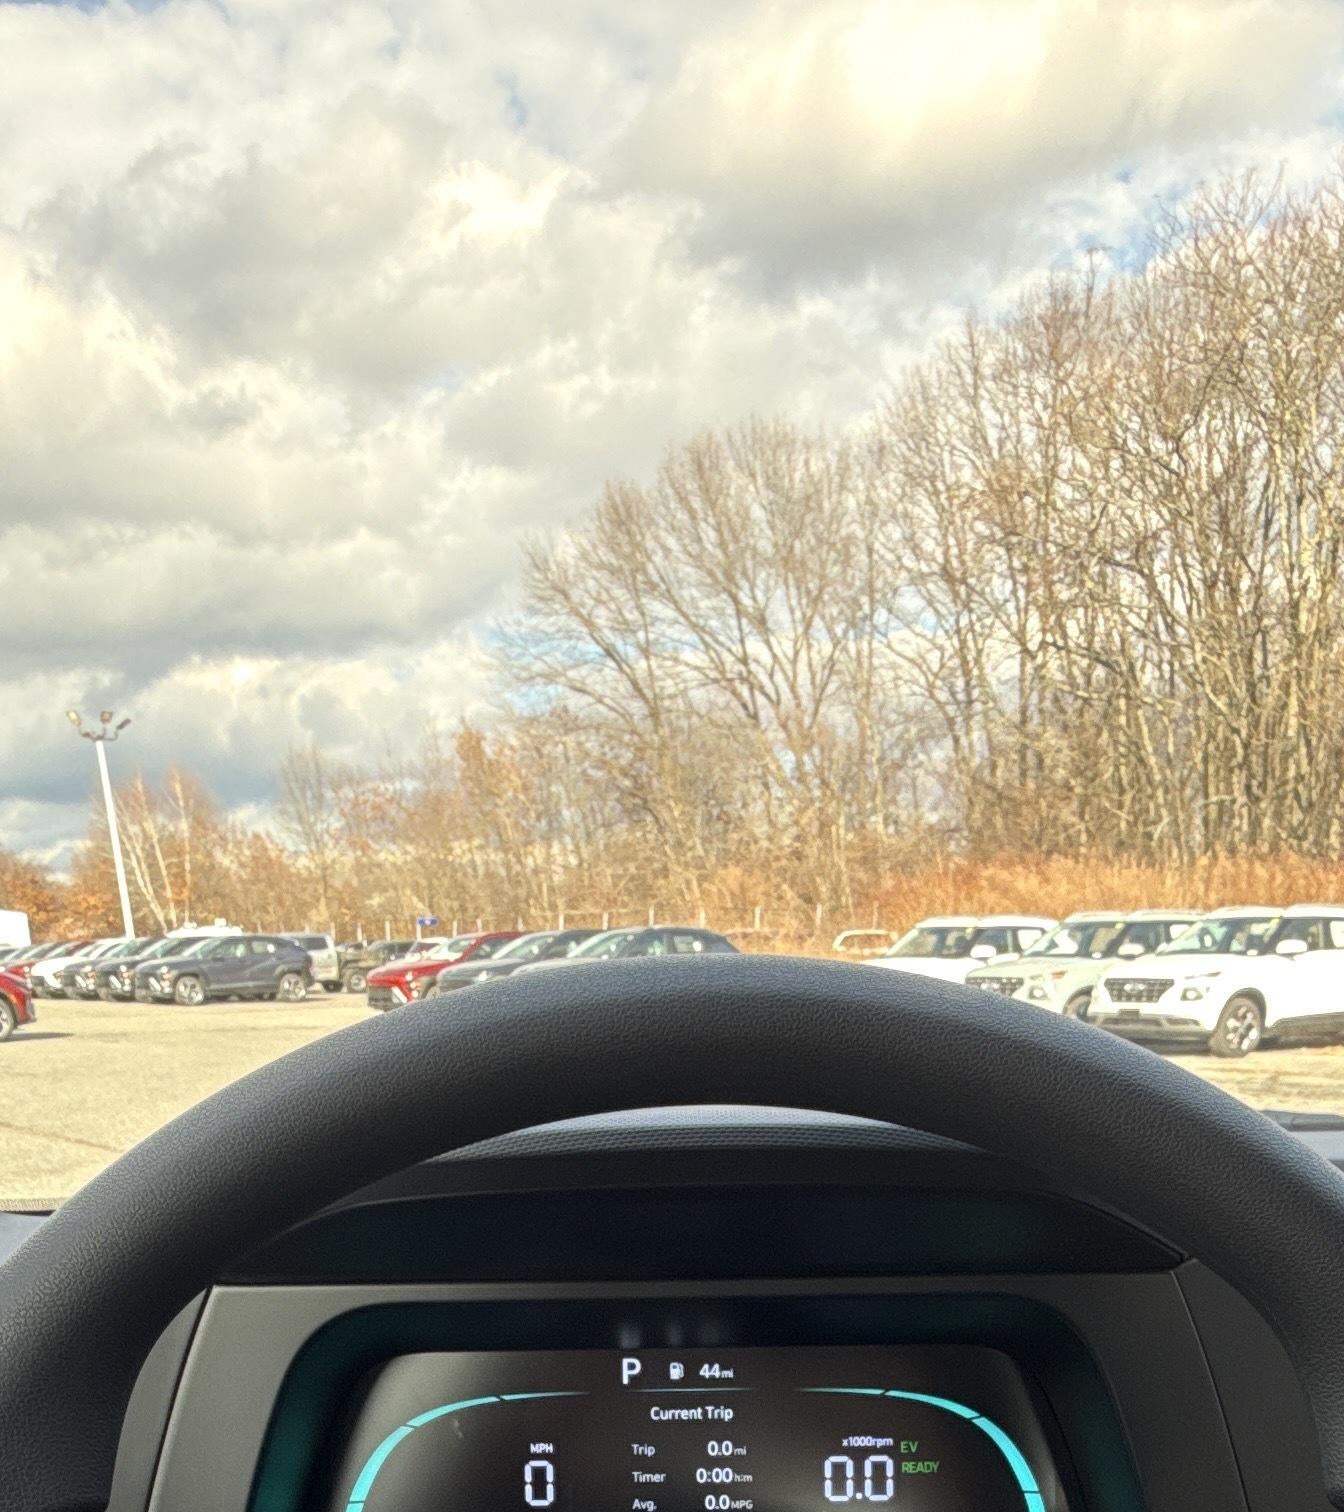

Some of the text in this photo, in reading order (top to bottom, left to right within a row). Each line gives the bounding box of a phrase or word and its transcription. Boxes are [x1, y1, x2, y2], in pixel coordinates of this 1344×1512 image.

[622, 1357, 642, 1385] P
[650, 1405, 734, 1422] Current Trip
[530, 1443, 554, 1454] MPH
[842, 1436, 894, 1449] x1000rpm
[900, 1441, 919, 1453] EV
[632, 1443, 656, 1457] Trip
[901, 1461, 941, 1474] READY
[524, 1460, 554, 1507] 0
[632, 1472, 667, 1483] Timer
[824, 1455, 894, 1502] 0.0
[632, 1498, 657, 1512] Avg.
